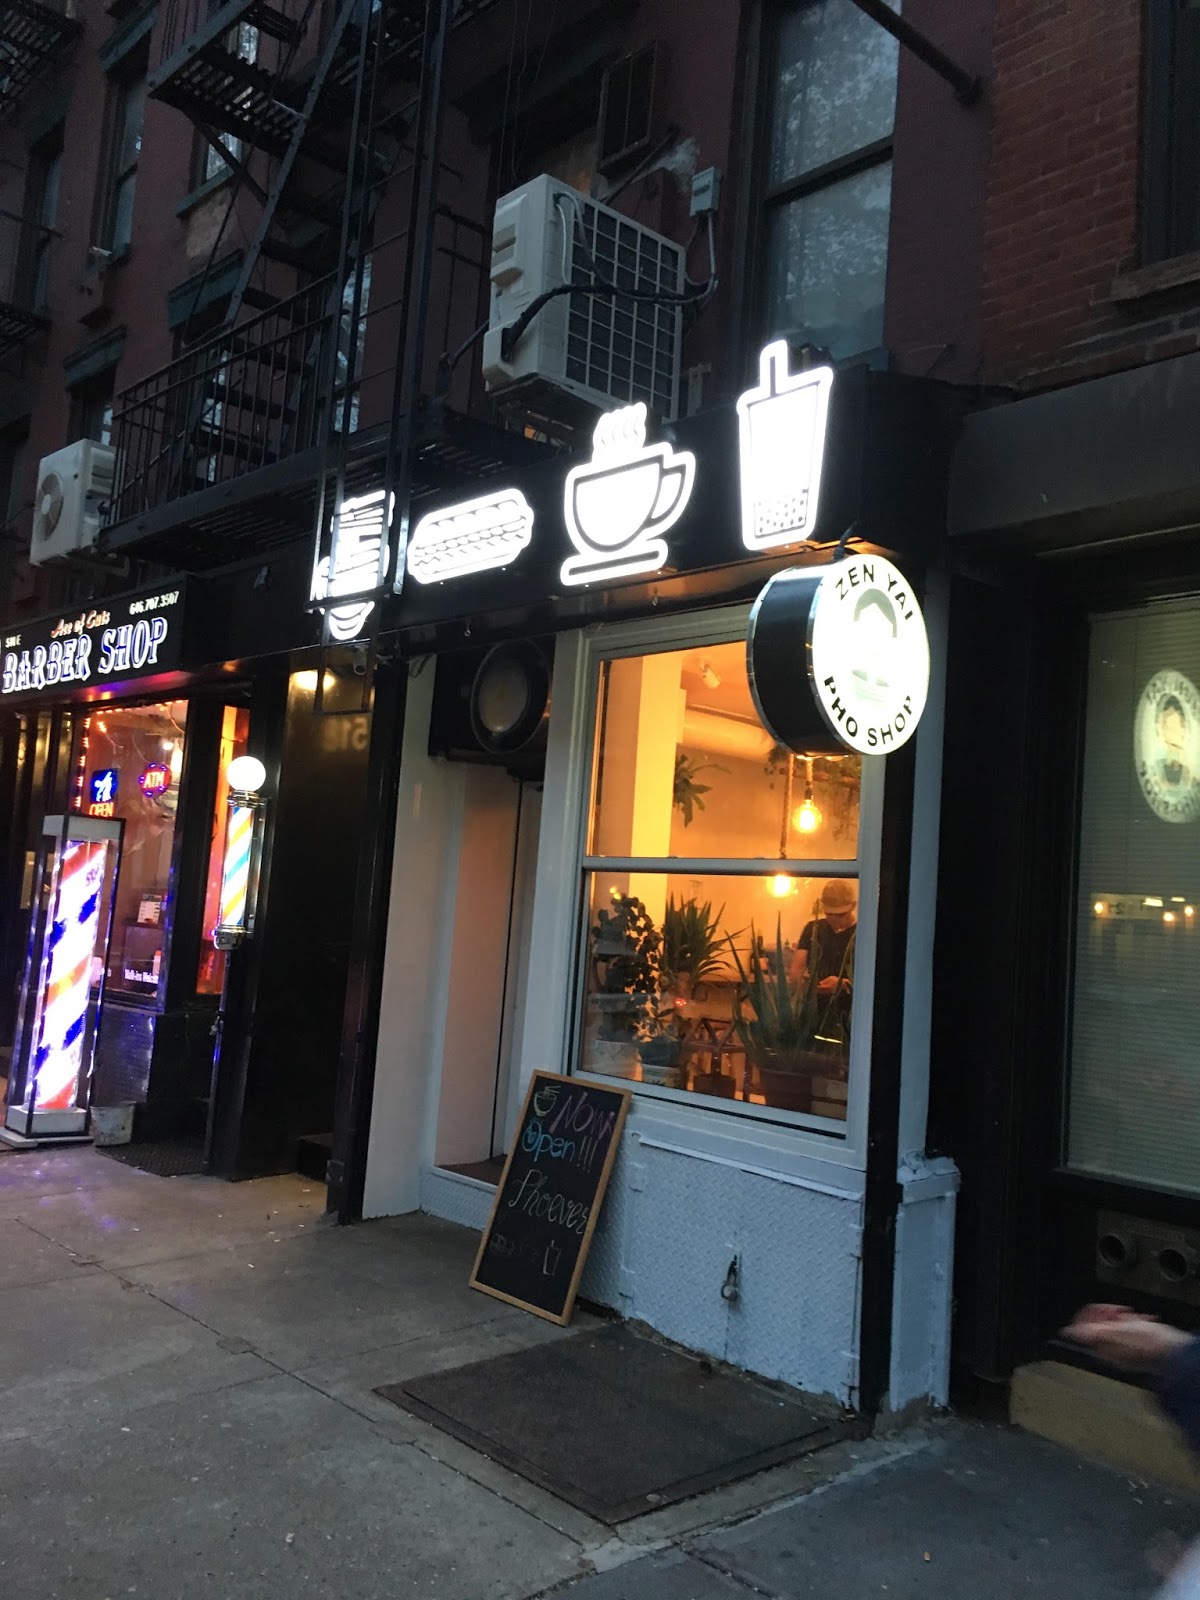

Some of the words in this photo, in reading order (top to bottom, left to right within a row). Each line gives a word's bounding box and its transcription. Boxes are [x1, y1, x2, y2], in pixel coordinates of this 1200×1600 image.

[835, 564, 875, 600] ZEN
[887, 573, 914, 620] YAI
[51, 618, 73, 639] Ace
[73, 613, 86, 635] of
[86, 609, 111, 630] Cuts
[2, 633, 92, 694] BARBER
[98, 616, 168, 674] SHOP
[823, 676, 858, 738] PHO
[867, 695, 913, 747] SHOP
[143, 771, 165, 789] ATM
[89, 802, 114, 817] OPEN
